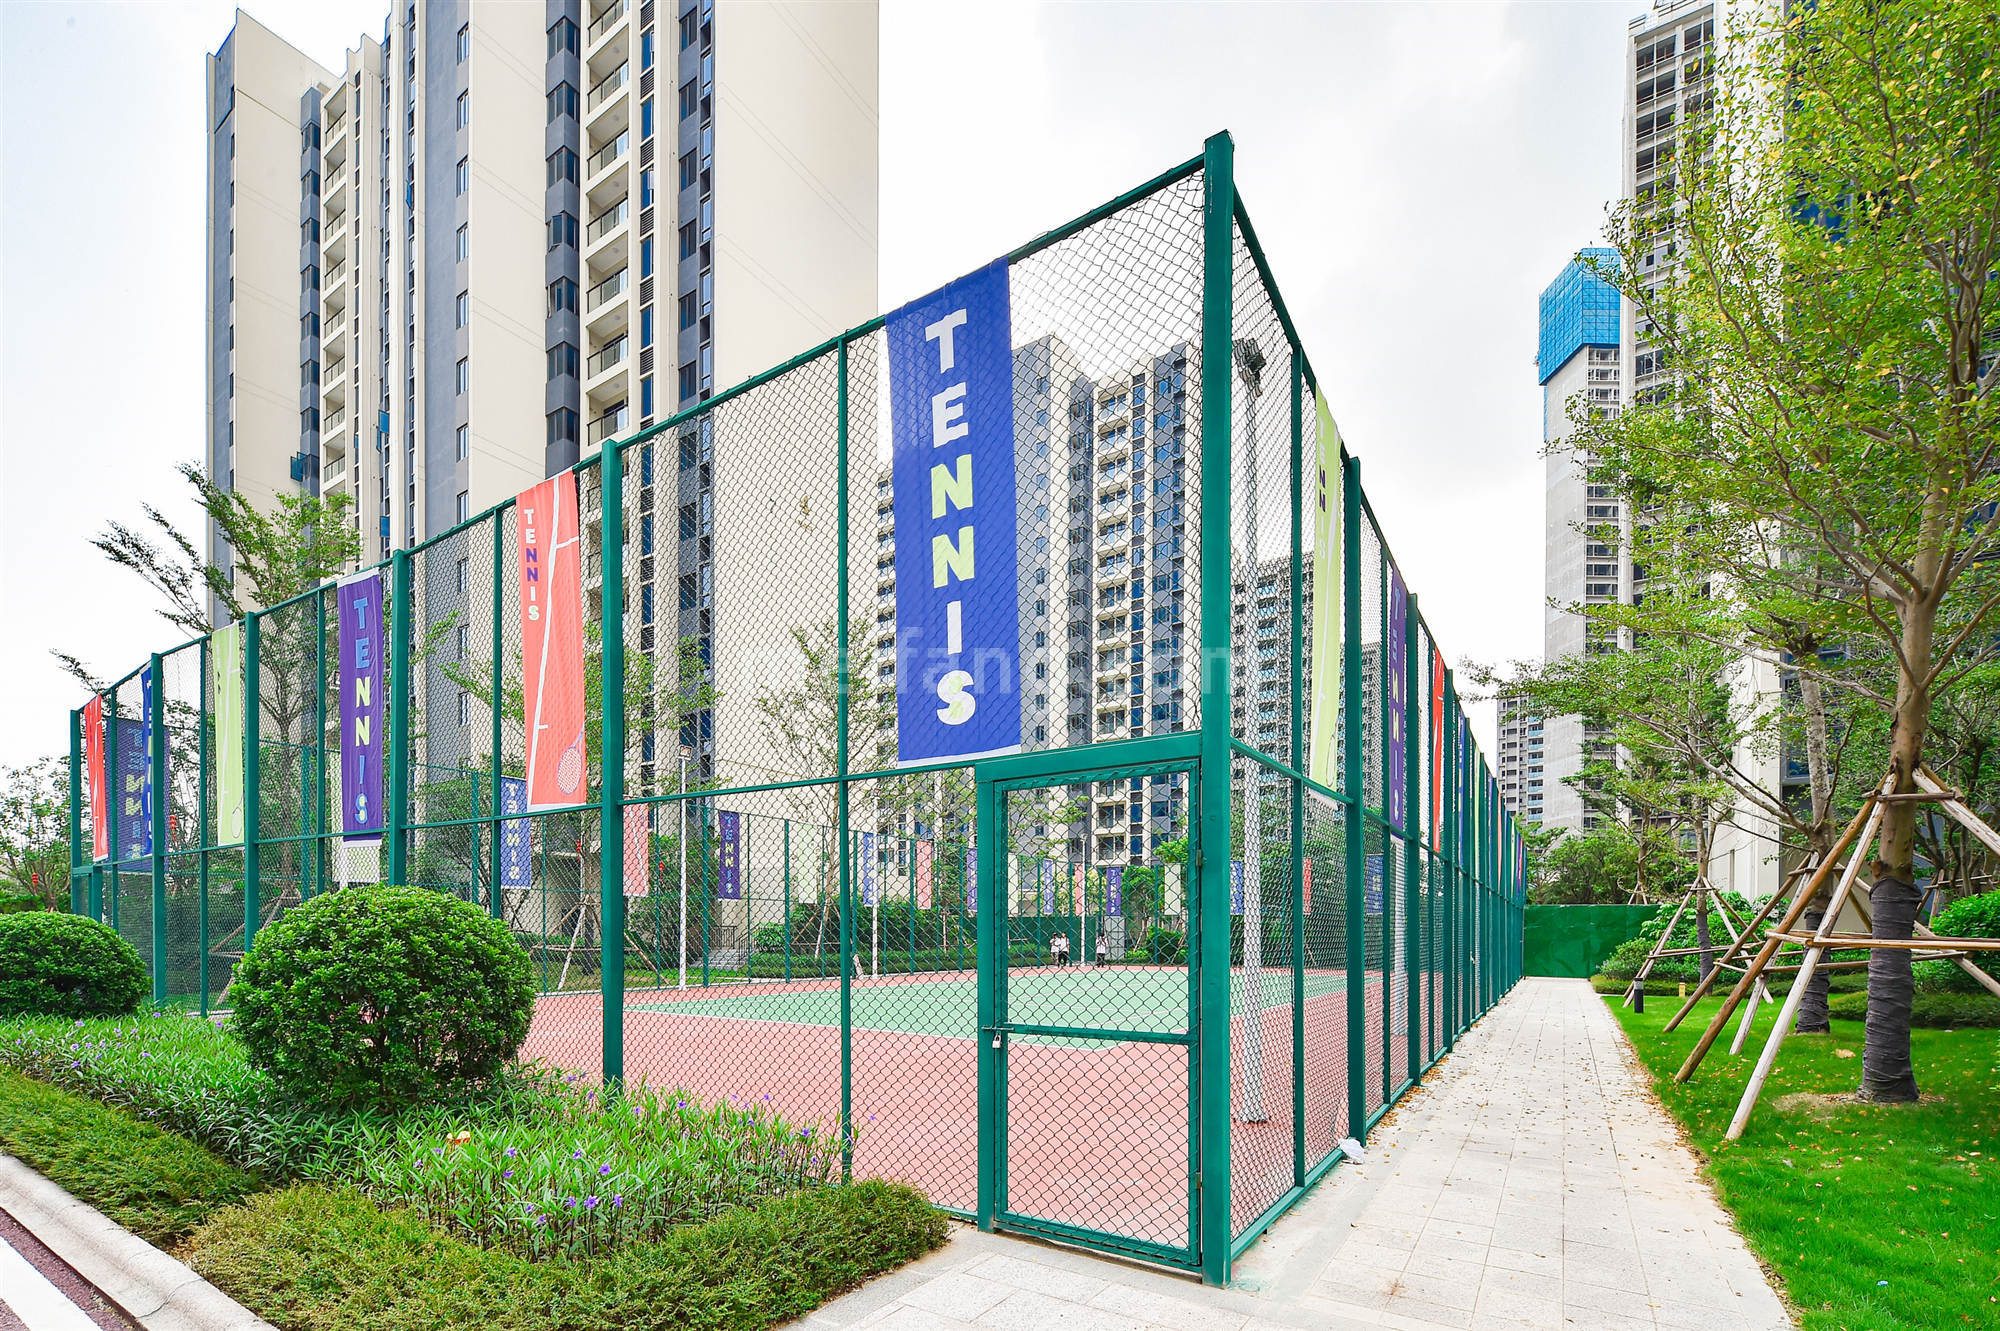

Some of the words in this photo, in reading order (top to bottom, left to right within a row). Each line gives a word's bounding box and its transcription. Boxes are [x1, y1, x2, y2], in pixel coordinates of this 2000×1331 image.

[523, 508, 540, 621] TENNIS
[925, 308, 976, 726] TENNIS
[353, 596, 371, 824] TENNIS
